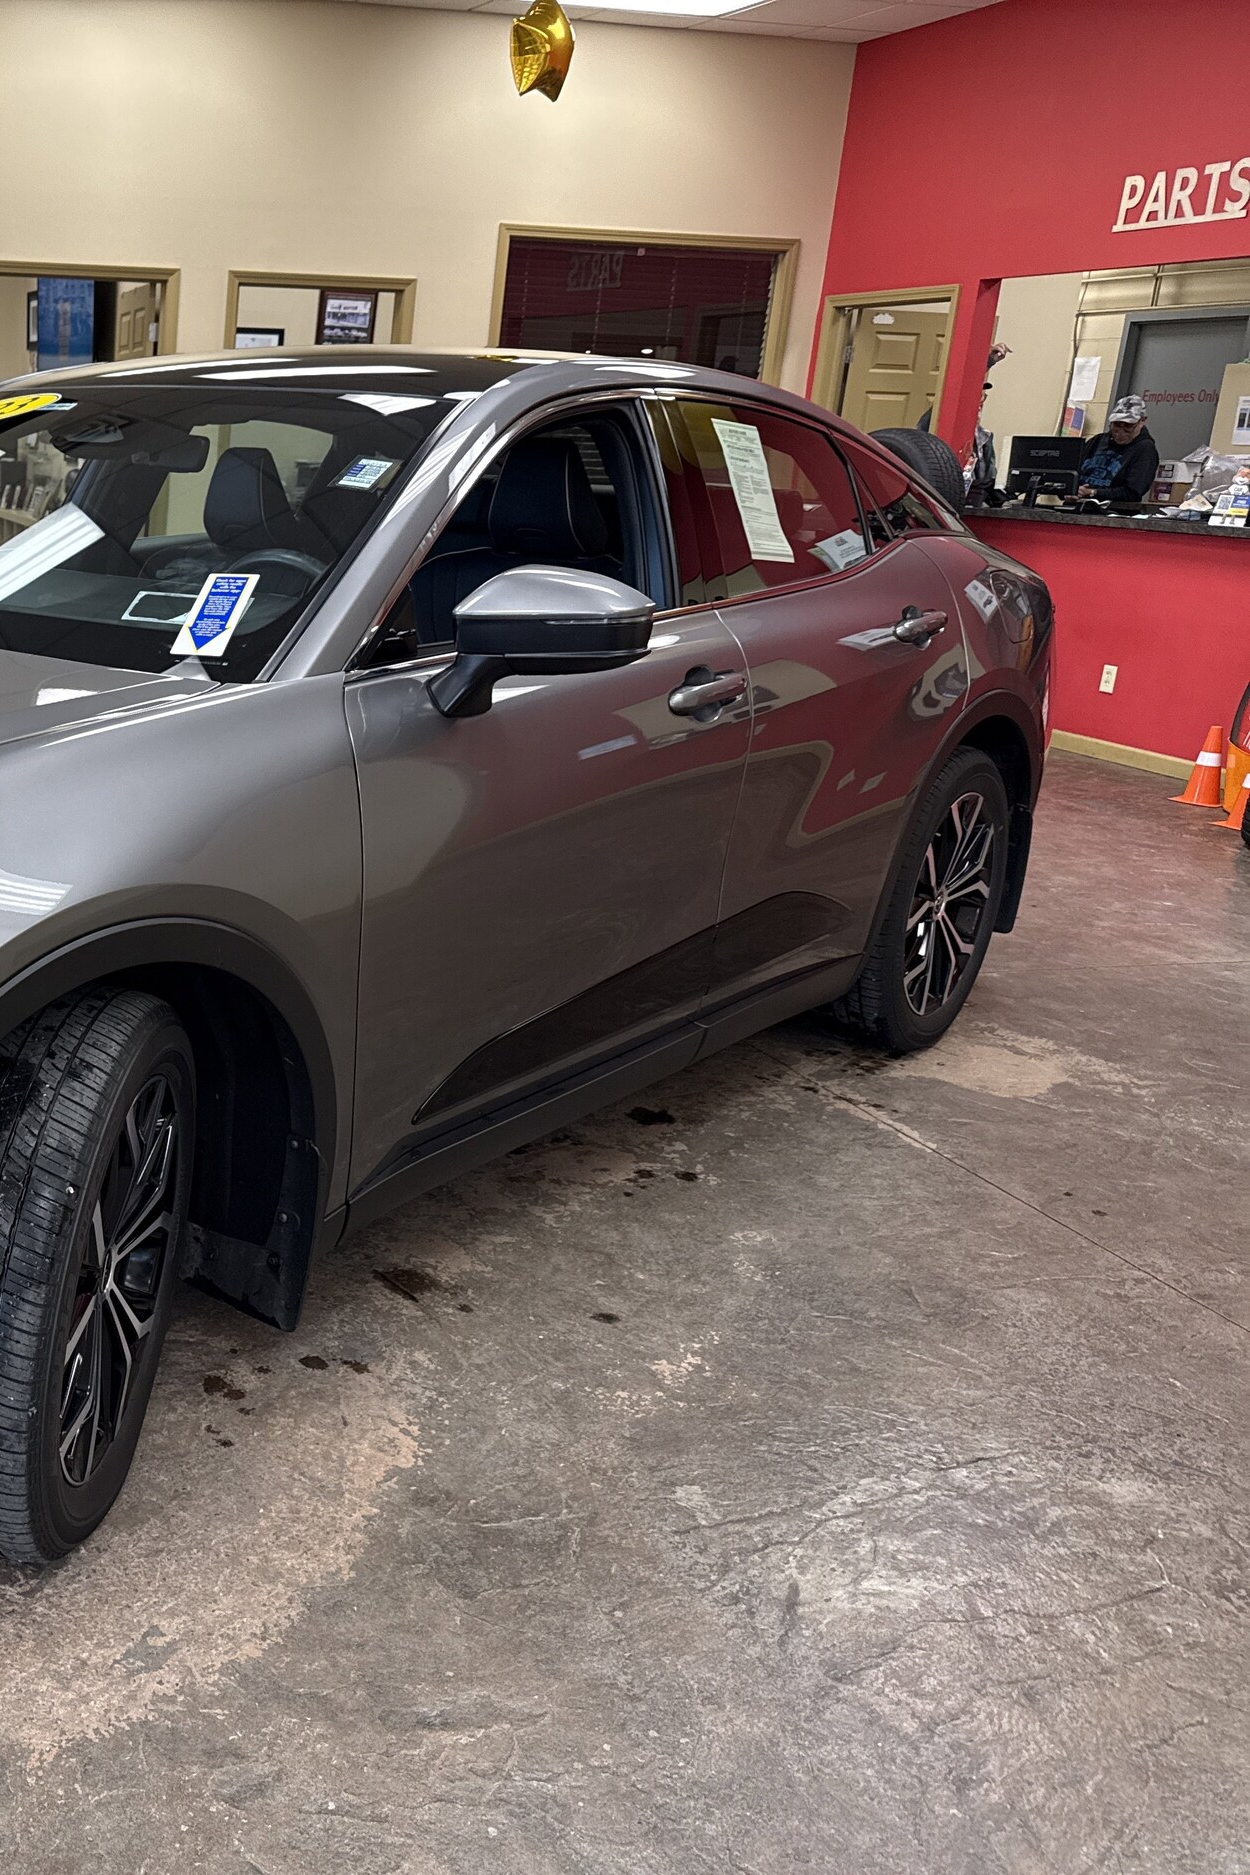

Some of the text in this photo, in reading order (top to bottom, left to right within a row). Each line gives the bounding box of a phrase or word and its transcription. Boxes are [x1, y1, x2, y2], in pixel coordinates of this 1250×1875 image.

[1112, 157, 1250, 231] PARTS
[1142, 389, 1219, 407] Employees Only
